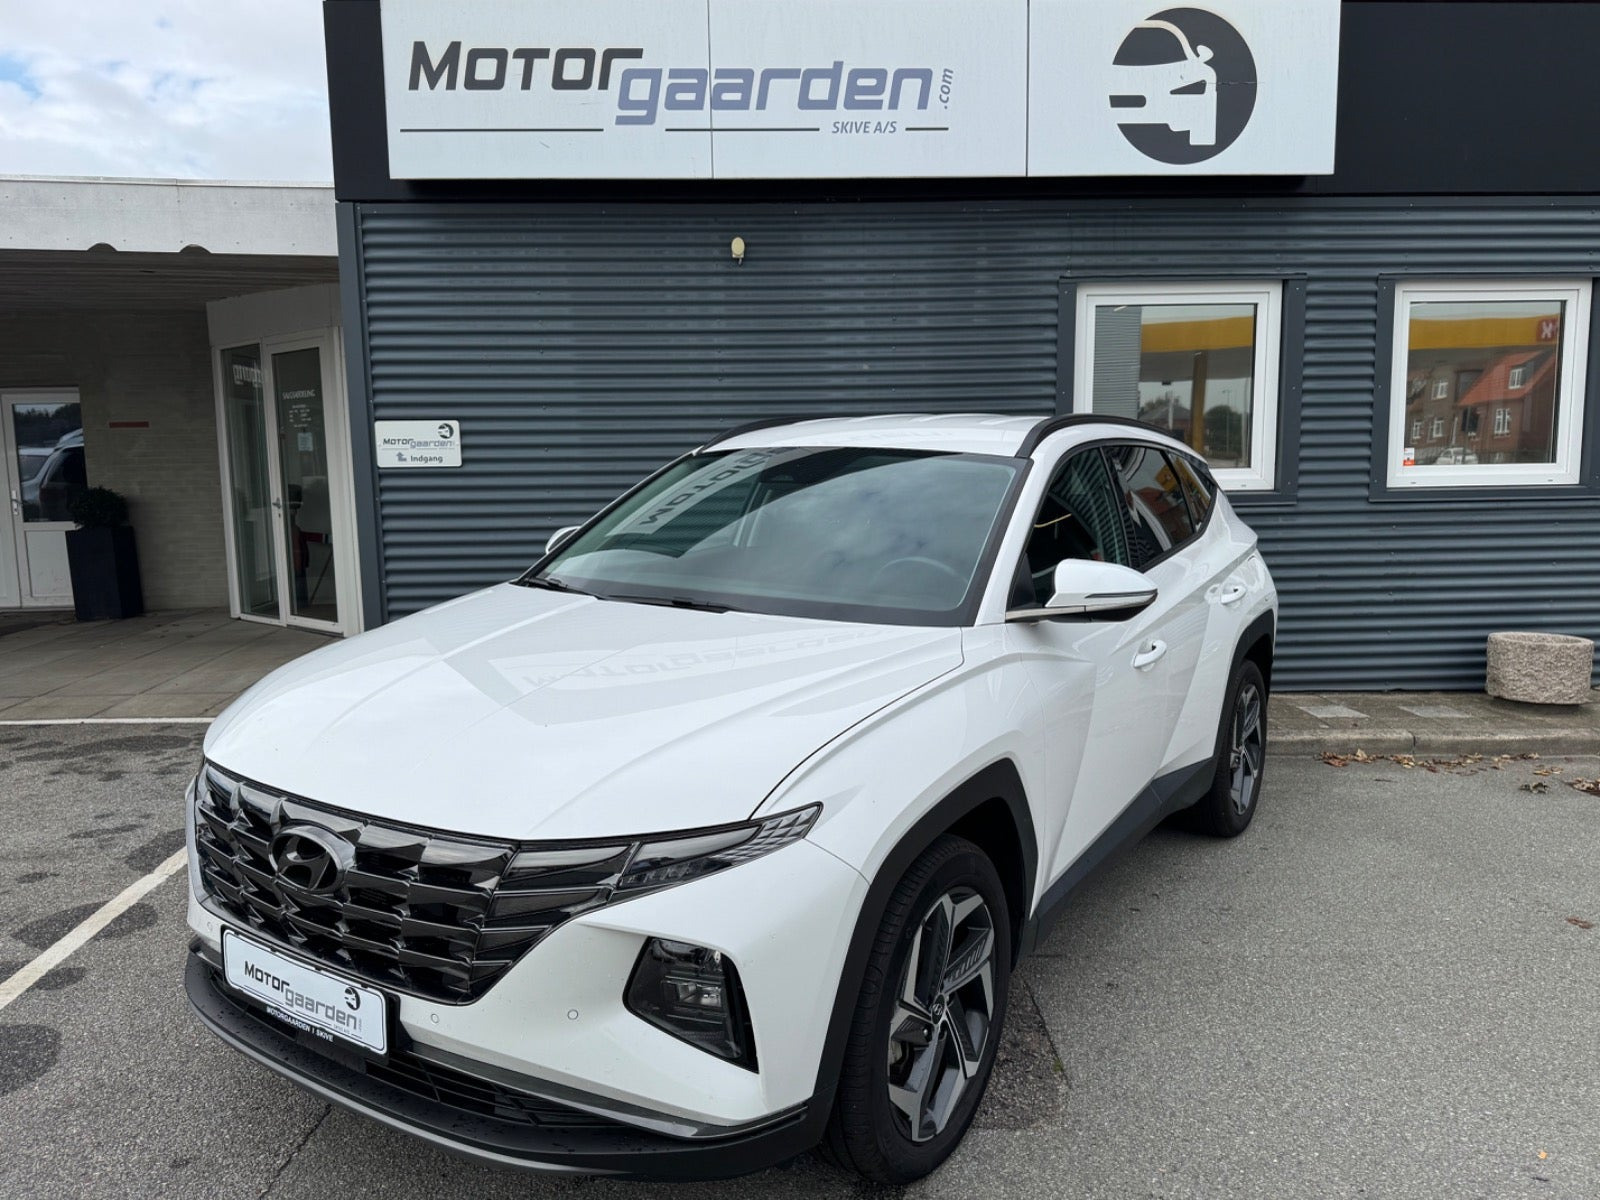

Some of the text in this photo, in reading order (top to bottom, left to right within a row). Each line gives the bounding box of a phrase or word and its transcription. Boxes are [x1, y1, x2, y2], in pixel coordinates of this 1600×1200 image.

[939, 68, 954, 110] .com
[832, 121, 897, 134] SKIVE A/S
[410, 455, 444, 463] Indgang
[316, 1029, 334, 1043] SKIVE
